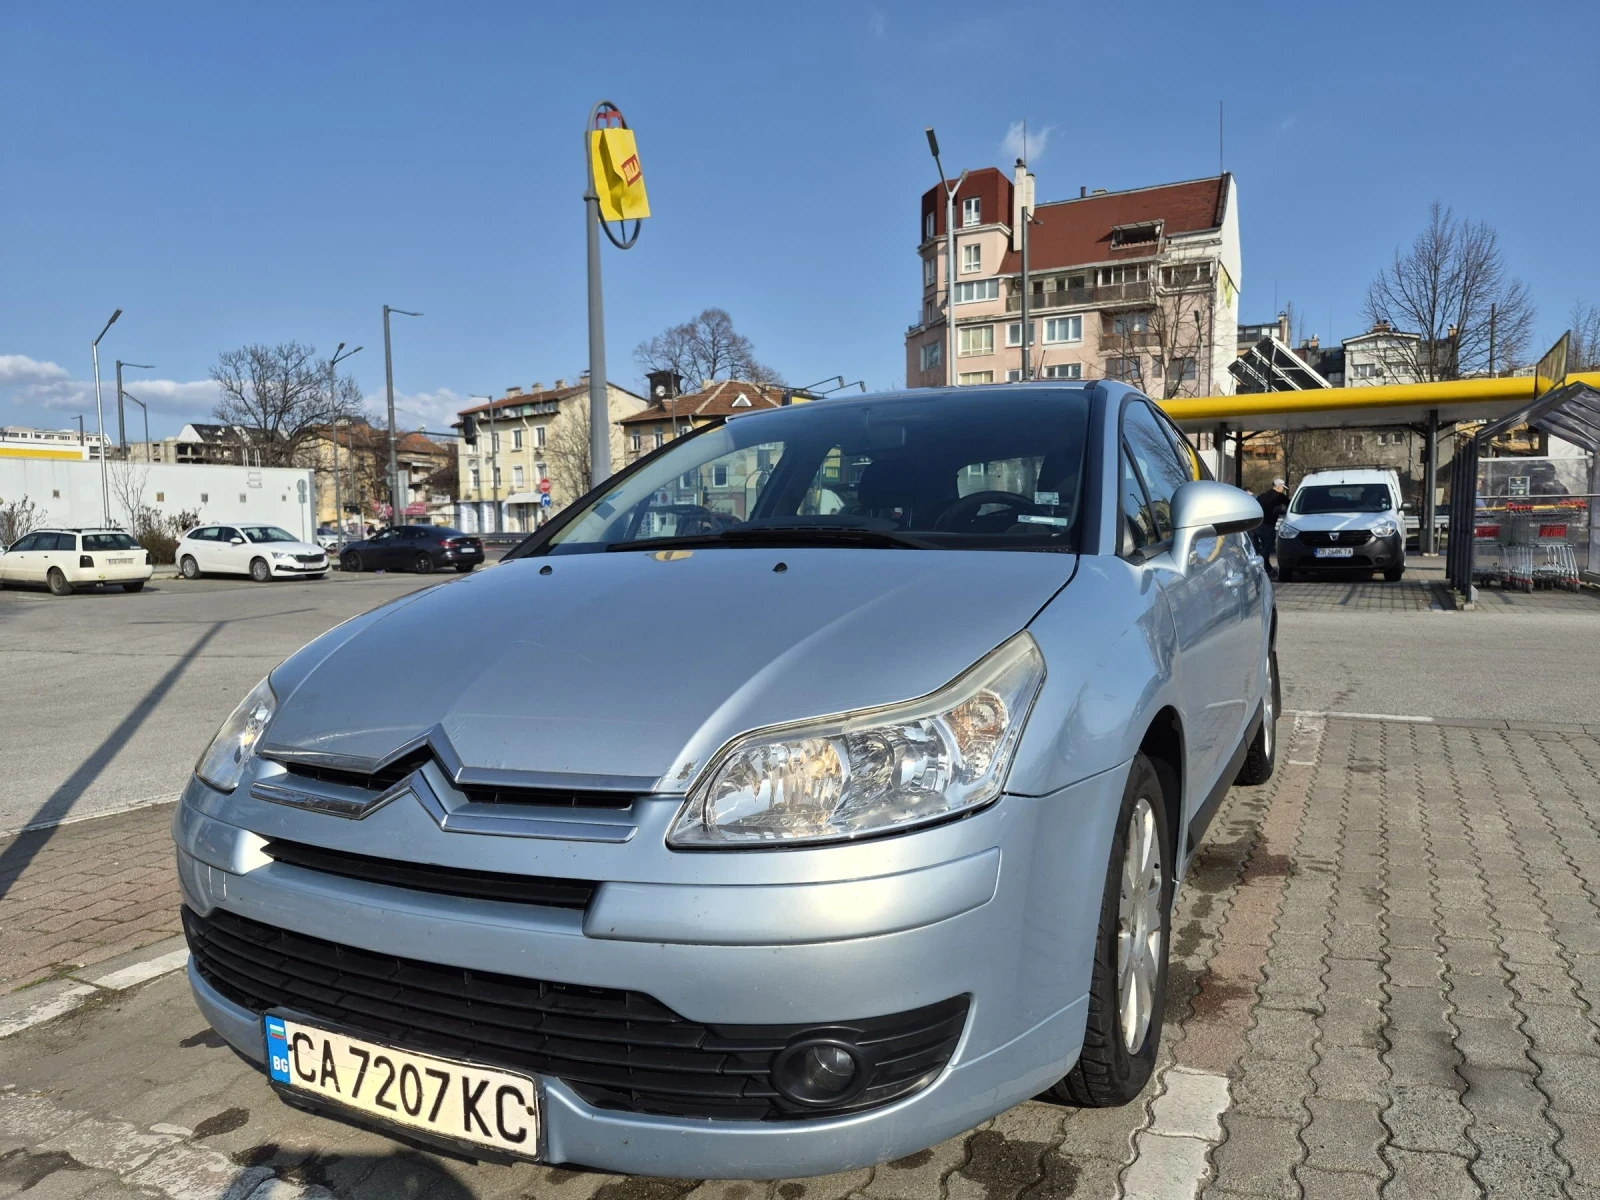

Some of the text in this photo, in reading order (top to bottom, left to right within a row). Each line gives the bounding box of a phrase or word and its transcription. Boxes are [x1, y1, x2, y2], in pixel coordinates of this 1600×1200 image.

[273, 1056, 288, 1073] BG
[292, 1032, 527, 1143] CA 7207 KC
